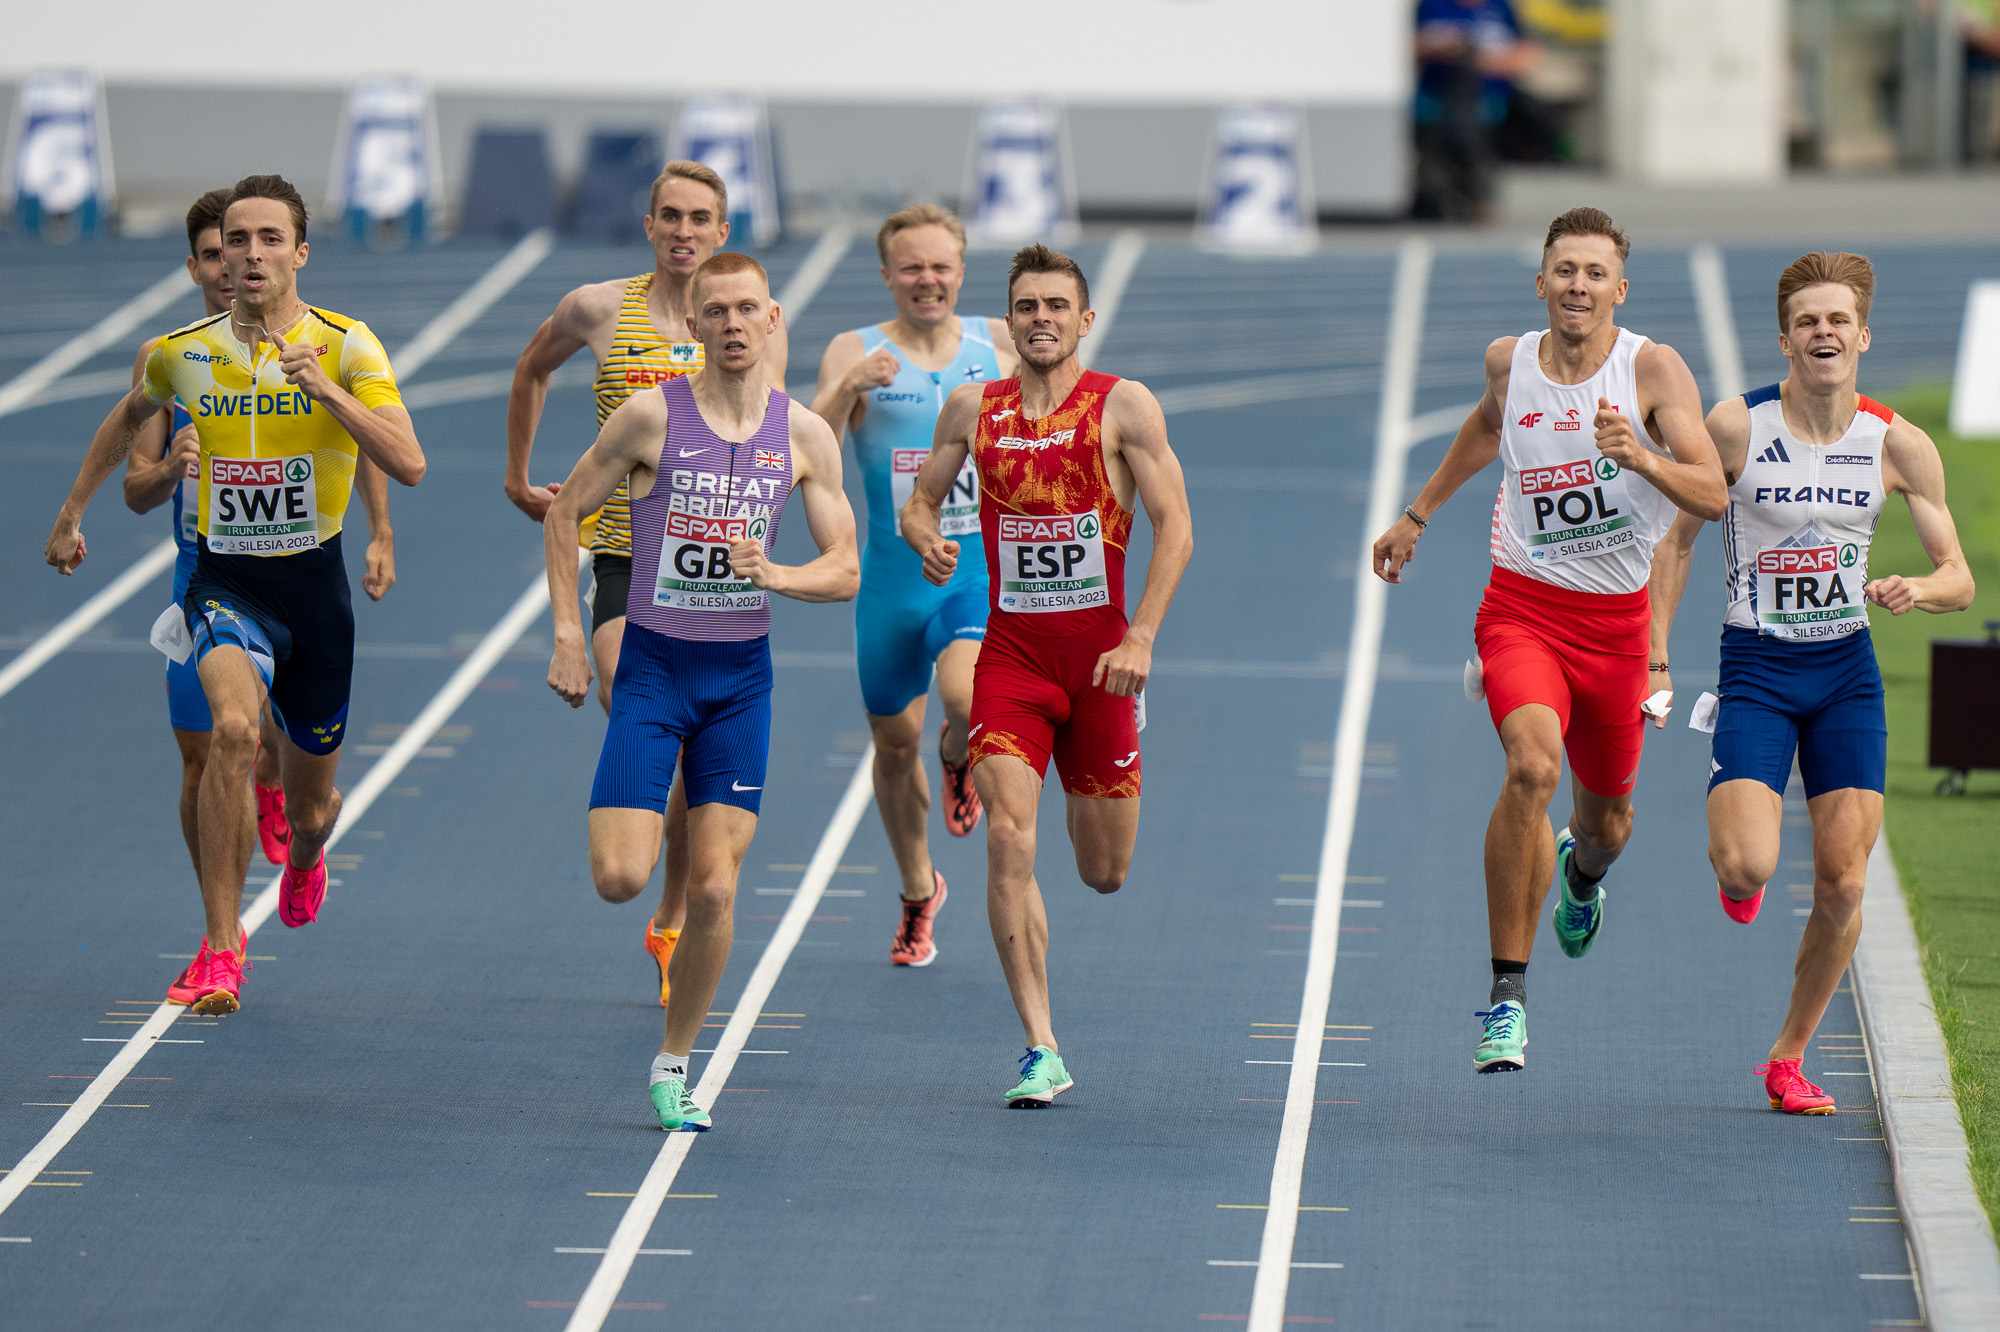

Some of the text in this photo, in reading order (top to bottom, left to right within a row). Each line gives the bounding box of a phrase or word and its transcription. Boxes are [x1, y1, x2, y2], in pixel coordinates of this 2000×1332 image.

[24, 124, 90, 212] 6
[356, 128, 417, 218] 5
[1227, 154, 1288, 241] 2
[183, 351, 223, 365] CRAFT
[198, 392, 312, 417] SWEDEN
[877, 393, 914, 402] CRAFT
[1518, 412, 1544, 428] 4F
[994, 428, 1076, 451] ESPAÑA
[213, 463, 281, 484] SPAR
[1522, 463, 1592, 491] SPAR
[671, 469, 782, 500] GREAT
[218, 485, 308, 523] SWE
[1755, 486, 1870, 507] FRANCE
[1532, 486, 1619, 531] POL
[232, 525, 254, 536] RUN
[669, 515, 745, 540] SPAR
[1002, 520, 1073, 539] SPAR
[1551, 531, 1573, 542] RUN
[239, 535, 316, 551] SILESIA 2023
[1561, 540, 1604, 556] SILESIA
[1606, 530, 1634, 547] 2023
[674, 543, 732, 580] GB
[1017, 543, 1086, 579] ESP
[1760, 549, 1836, 571] SPAR
[685, 582, 708, 591] RUN
[1025, 582, 1046, 592] RUN
[1775, 572, 1849, 610] FRA
[689, 597, 734, 608] SILESIA
[736, 596, 761, 607] 2023
[1030, 596, 1076, 608] SILESIA
[1078, 590, 1106, 604] 2023
[1785, 613, 1808, 623] RUN
[1793, 620, 1865, 638] SILESIA 2023
